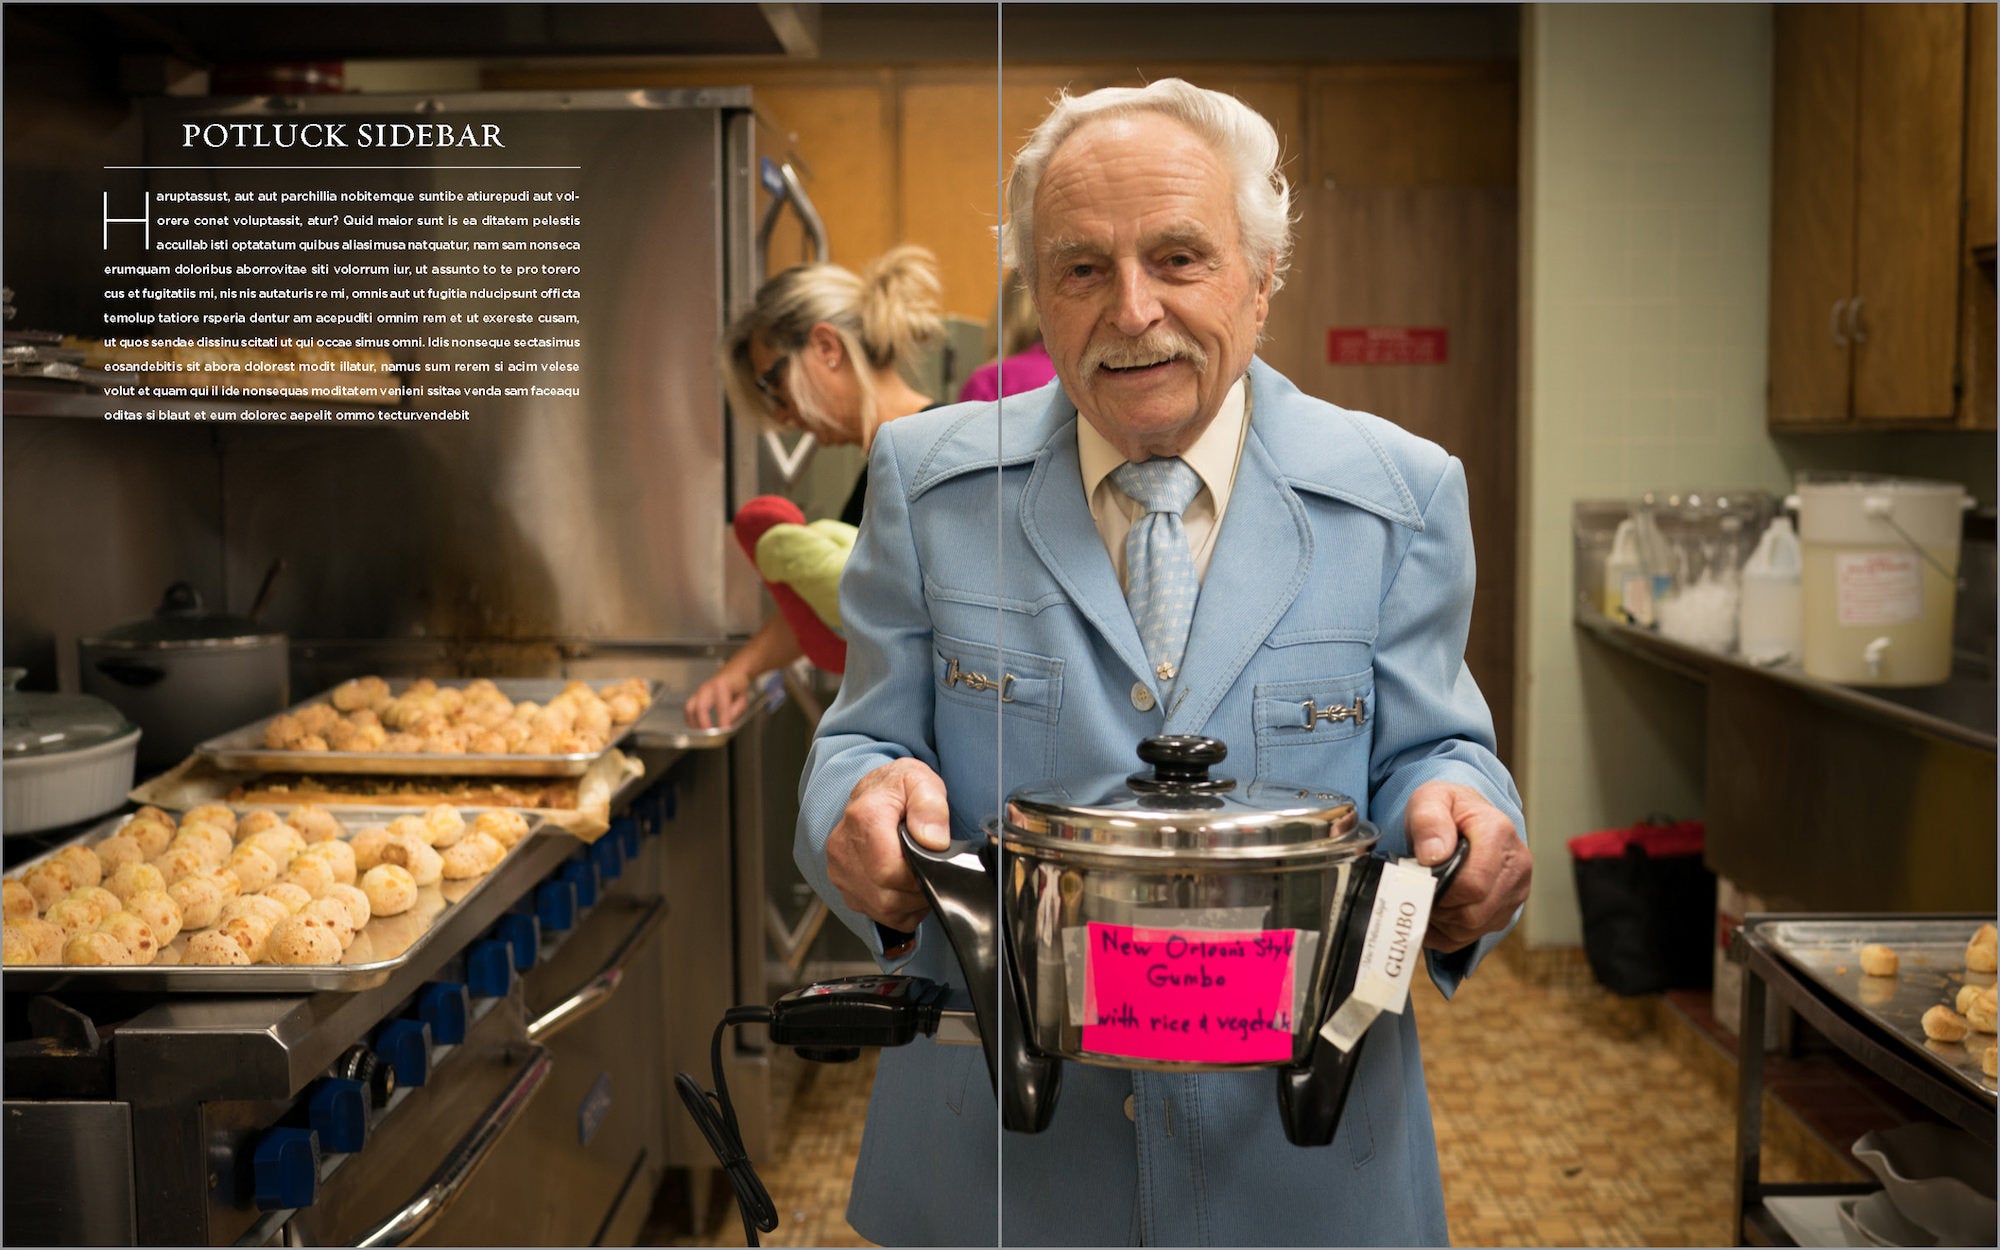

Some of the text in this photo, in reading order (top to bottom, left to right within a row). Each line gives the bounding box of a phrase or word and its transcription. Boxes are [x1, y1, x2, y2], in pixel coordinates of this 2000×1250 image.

[1102, 928, 1152, 956] New
[1385, 901, 1417, 978] GUMBO
[1147, 964, 1227, 988] Gumbo
[1097, 1002, 1139, 1028] with
[1151, 1015, 1191, 1033] rice
